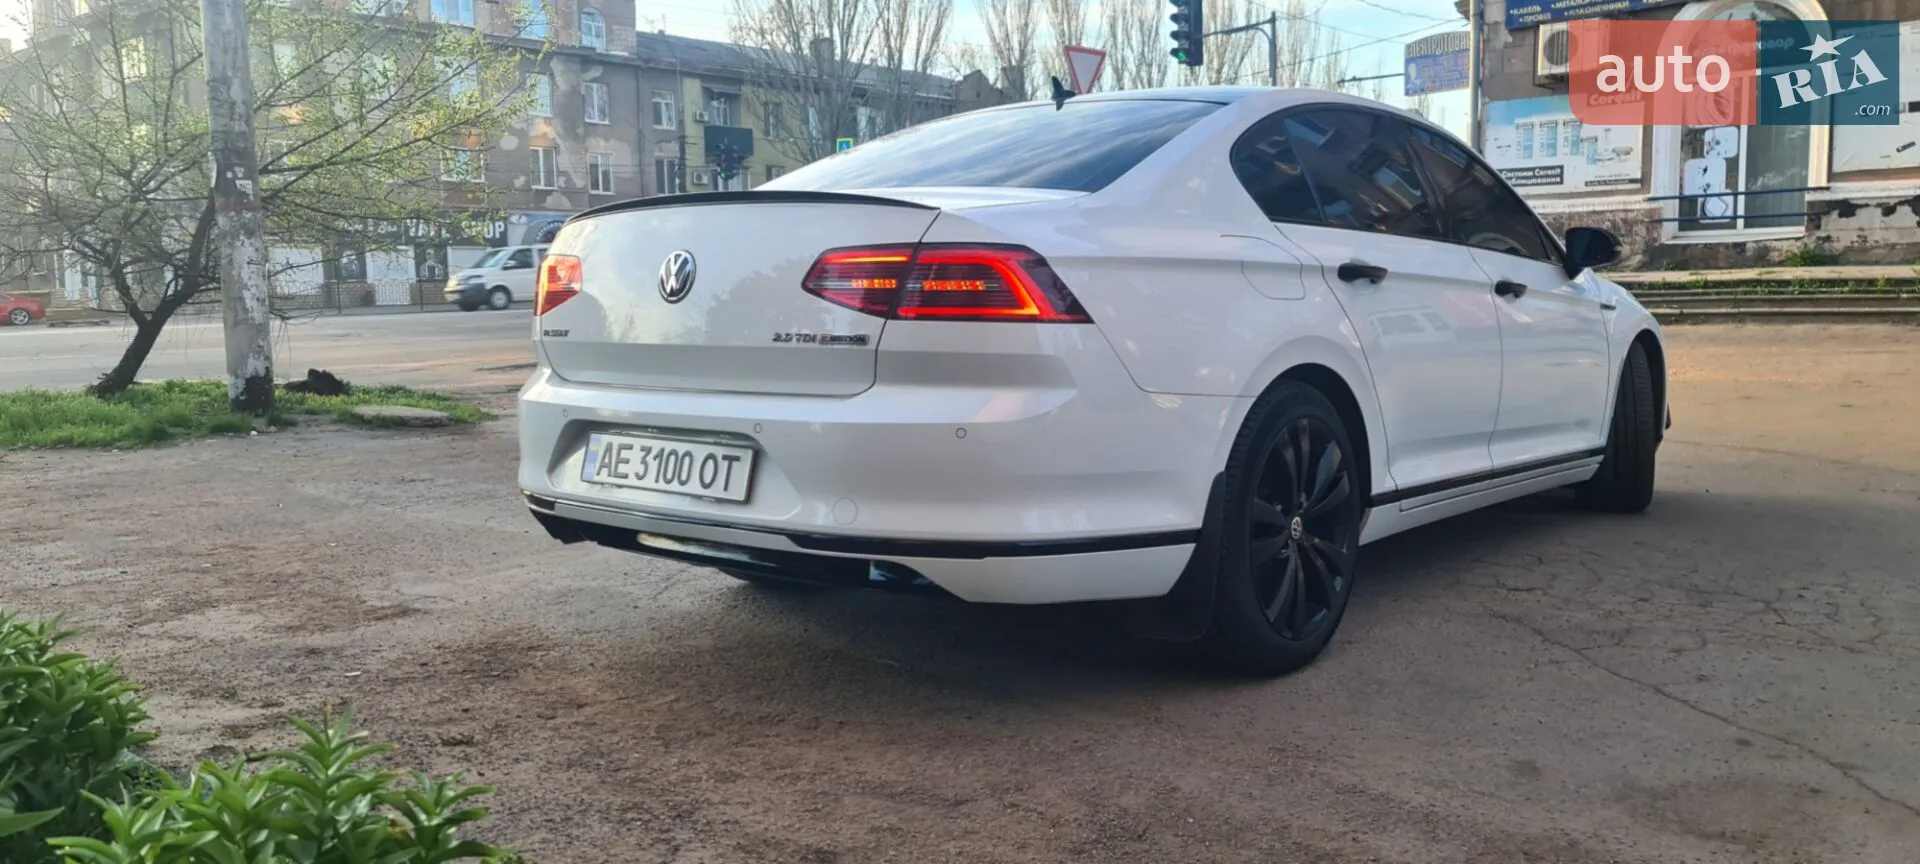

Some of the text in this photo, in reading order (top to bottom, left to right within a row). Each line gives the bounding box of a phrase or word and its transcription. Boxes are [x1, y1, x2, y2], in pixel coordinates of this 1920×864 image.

[794, 333, 817, 343] TDI
[596, 441, 741, 492] AE 3100 OT
